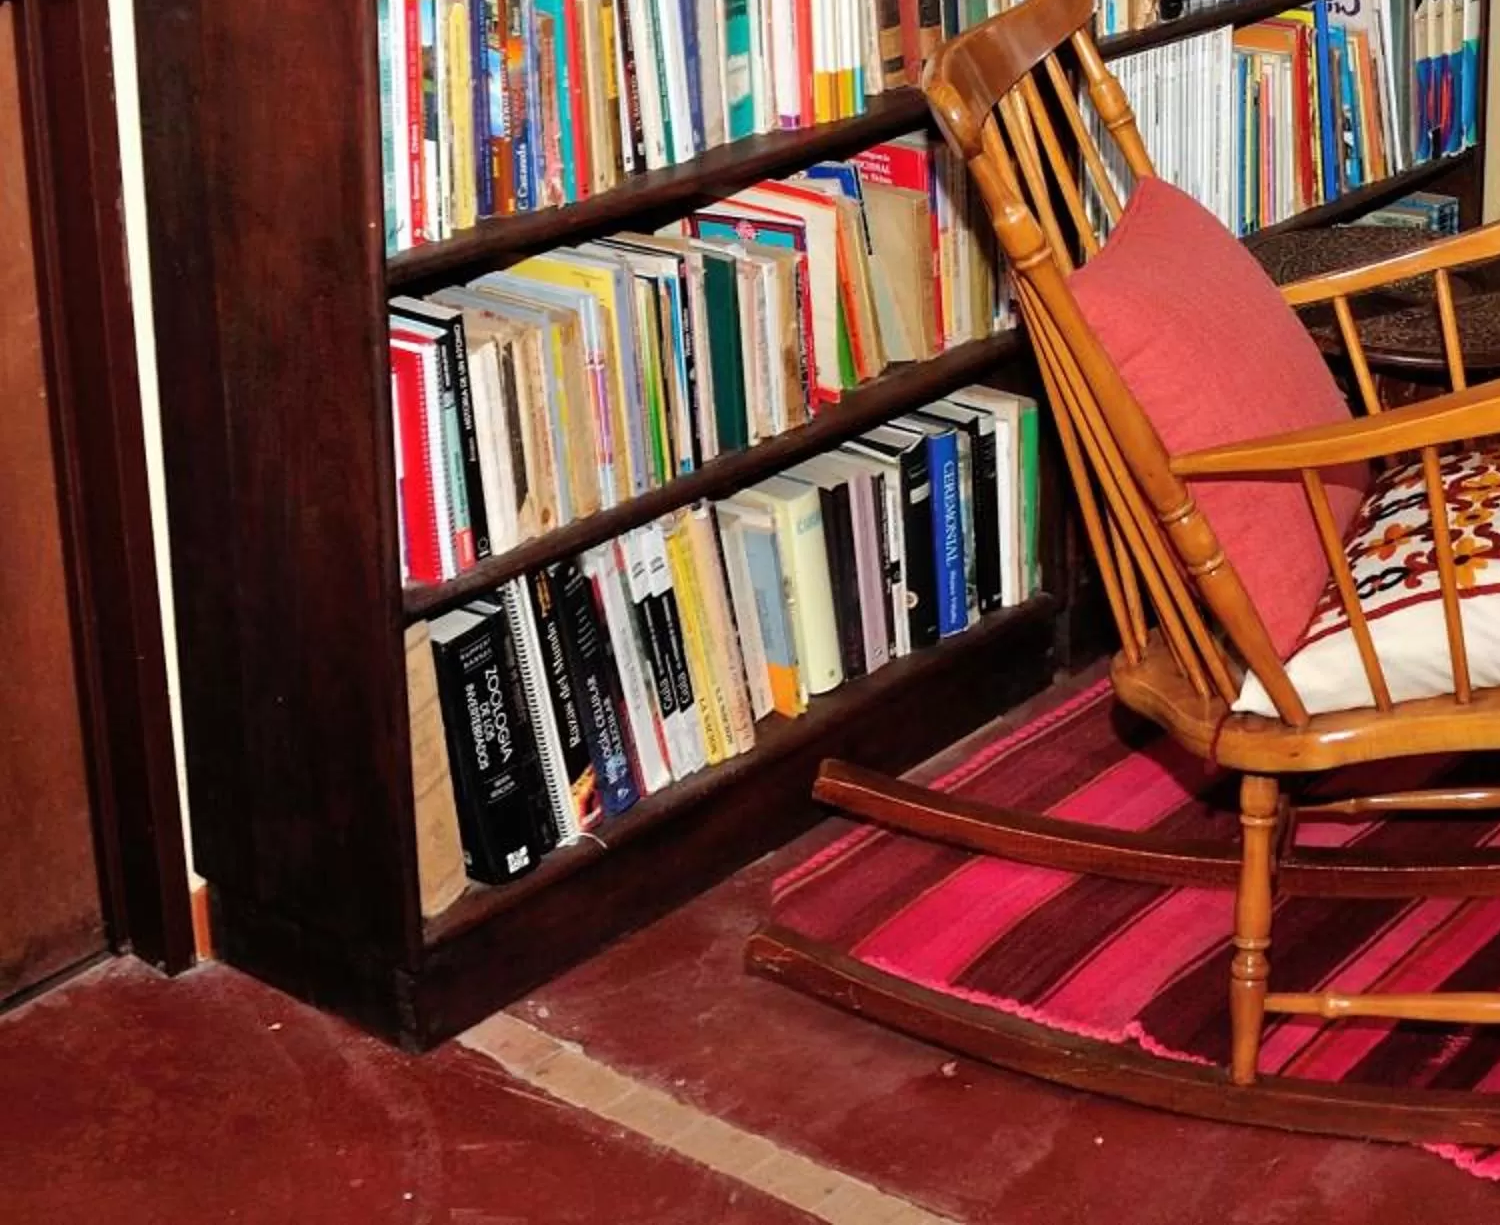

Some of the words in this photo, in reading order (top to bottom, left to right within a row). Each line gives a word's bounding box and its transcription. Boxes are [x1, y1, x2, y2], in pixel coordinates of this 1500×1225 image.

[942, 460, 960, 567] CEREMONIAL
[545, 621, 567, 675] Mundo
[484, 664, 514, 764] ZOOLOGIA
[560, 704, 580, 748] Razas
[587, 675, 605, 729] CELULAR
